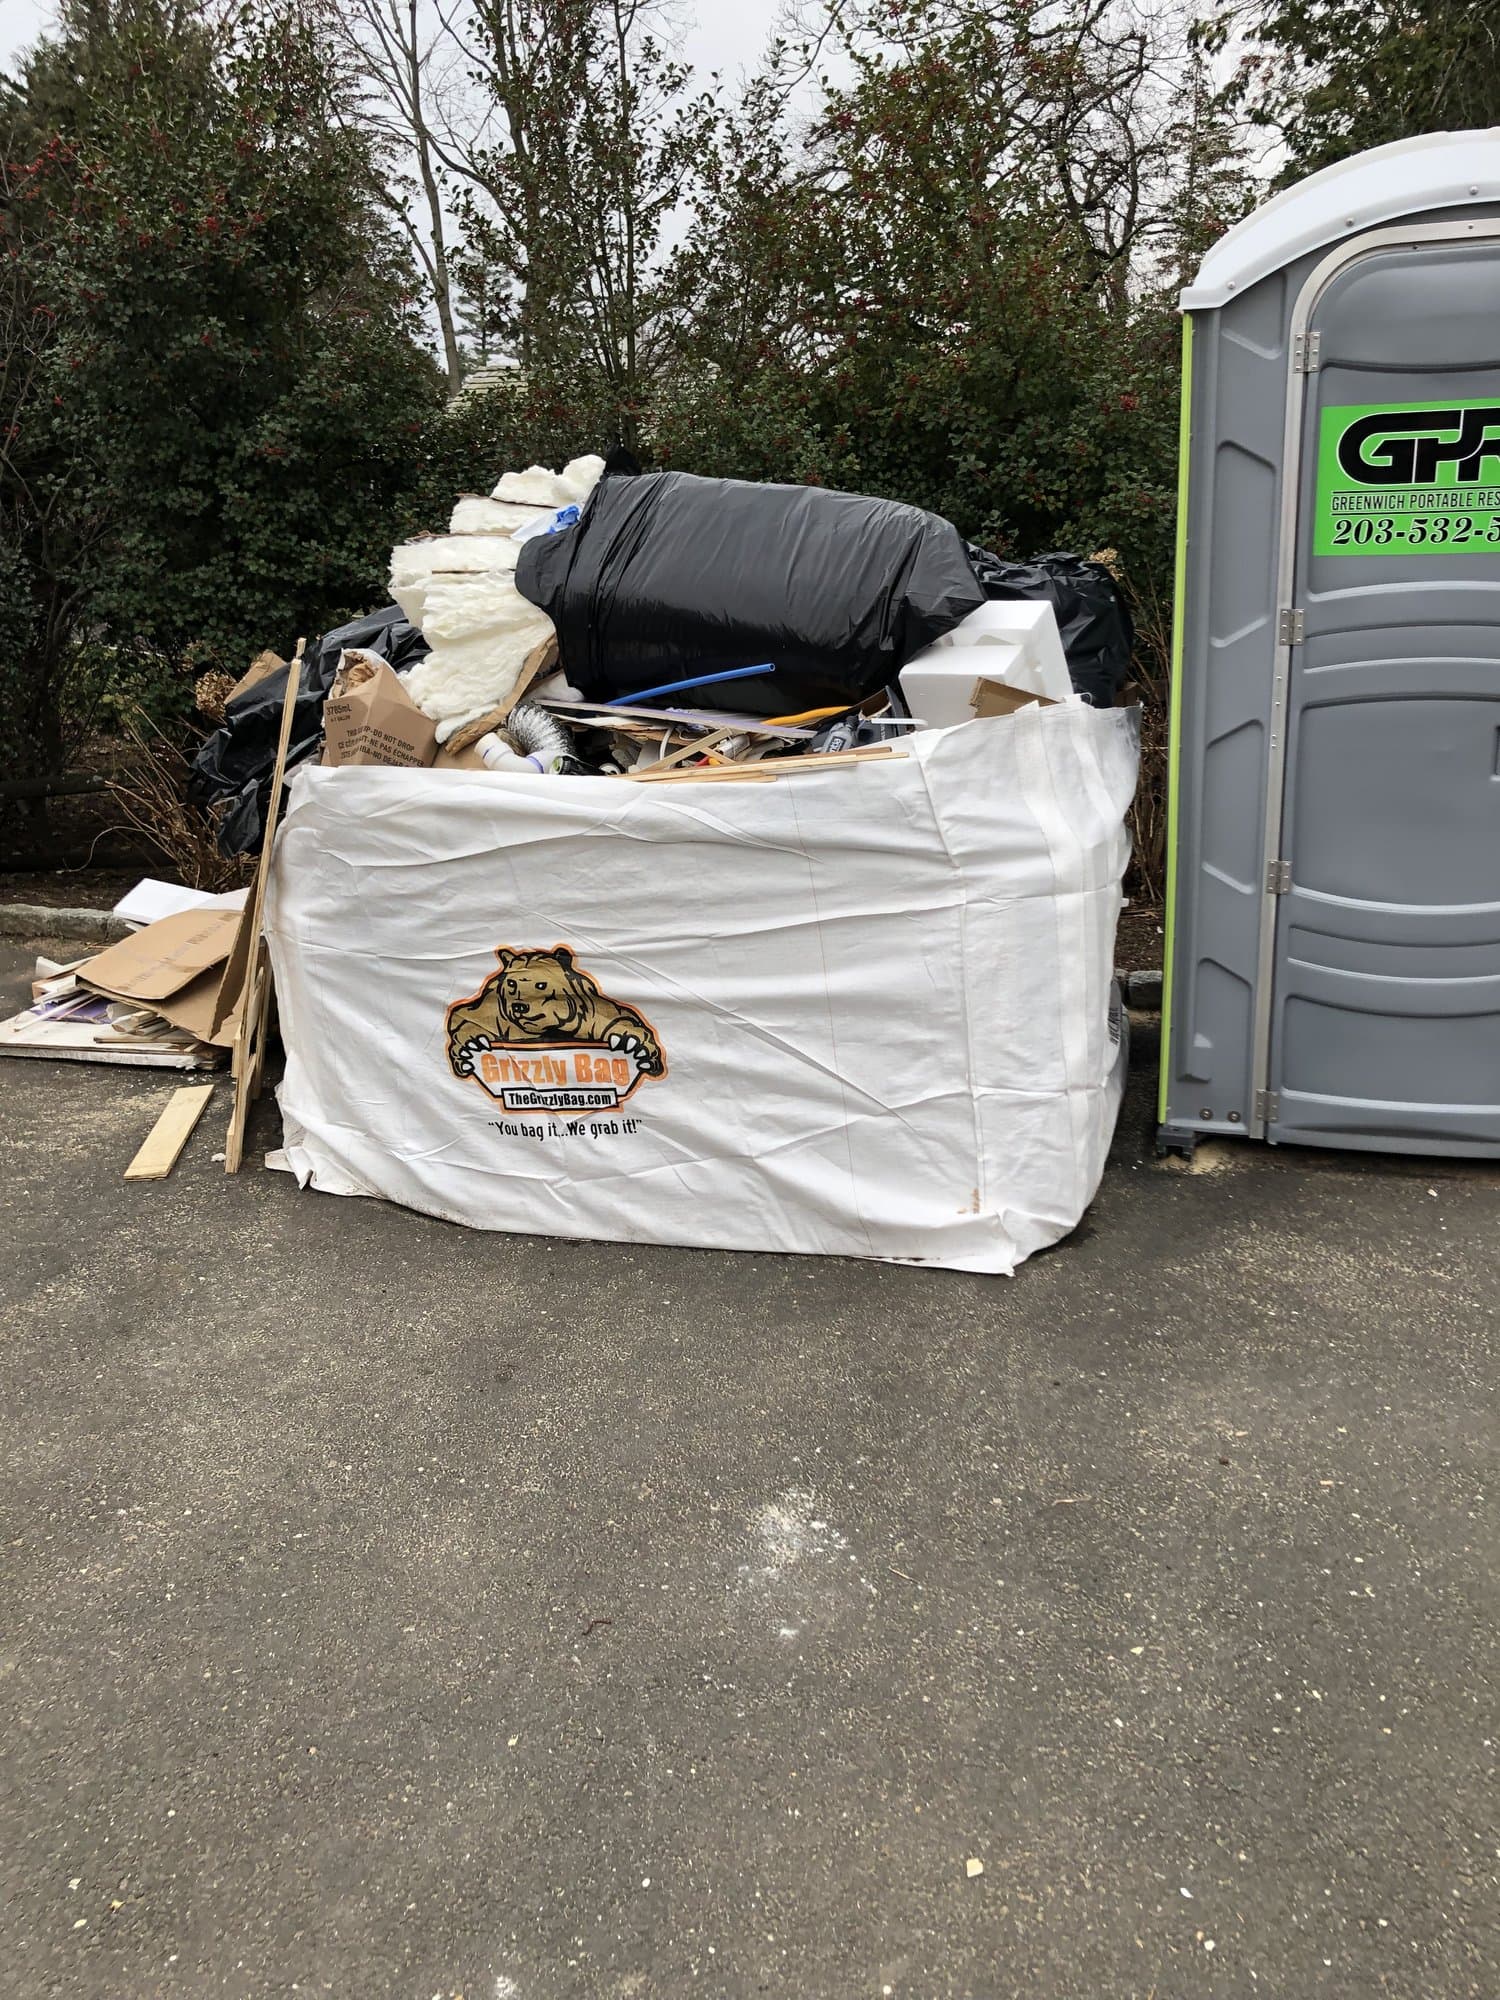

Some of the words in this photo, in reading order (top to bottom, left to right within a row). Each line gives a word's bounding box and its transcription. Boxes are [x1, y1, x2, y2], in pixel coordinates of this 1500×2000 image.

[1331, 494, 1404, 511] GREENWICH
[1409, 492, 1473, 509] PORTABLE
[380, 742, 392, 754] PAS
[384, 734, 397, 744] NOT
[397, 739, 415, 752] DROP
[480, 1053, 566, 1086] Grizzly
[573, 1053, 631, 1087] Bag
[508, 1092, 612, 1107] TheGrizzlyBag.com
[520, 1122, 544, 1141] bag
[590, 1119, 619, 1139] grab
